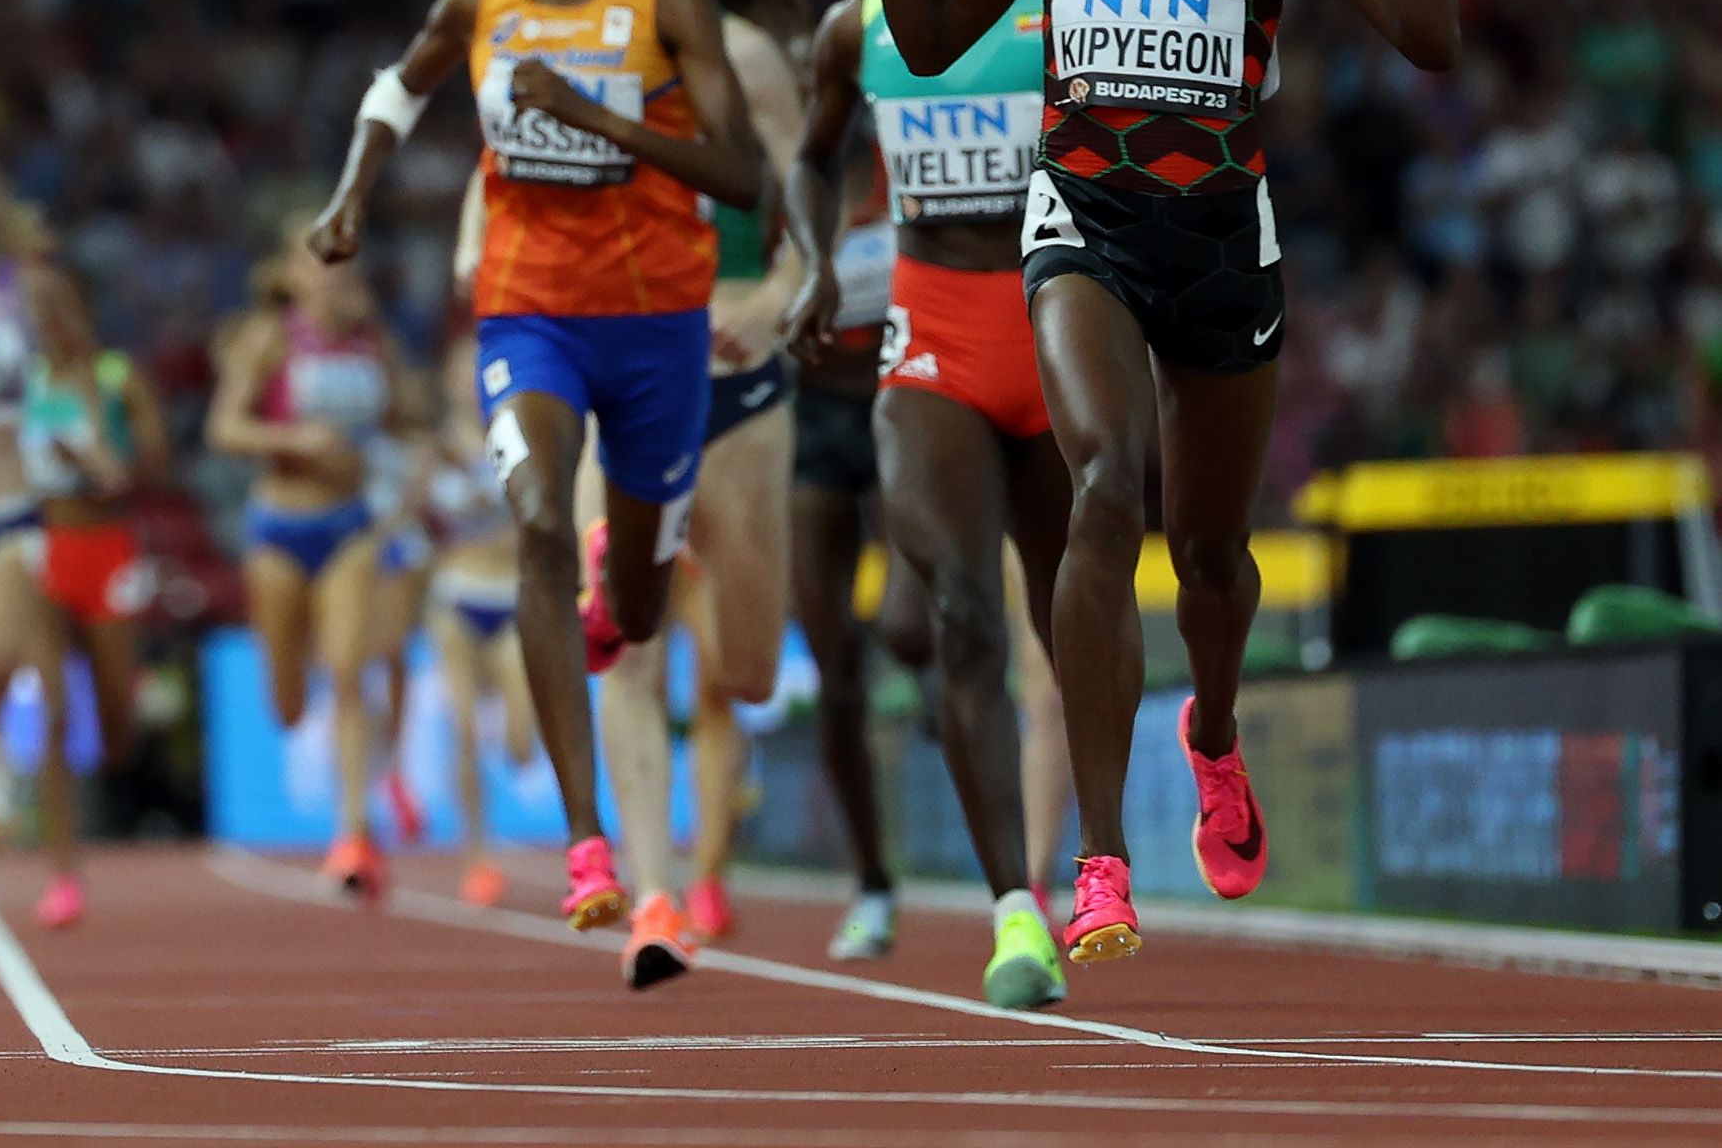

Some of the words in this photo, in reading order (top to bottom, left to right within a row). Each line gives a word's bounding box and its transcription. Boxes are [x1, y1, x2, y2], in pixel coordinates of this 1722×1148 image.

[1060, 26, 1232, 79] KIPYEGON
[1095, 81, 1204, 106] BUDAPEST
[900, 99, 1009, 140] NTN
